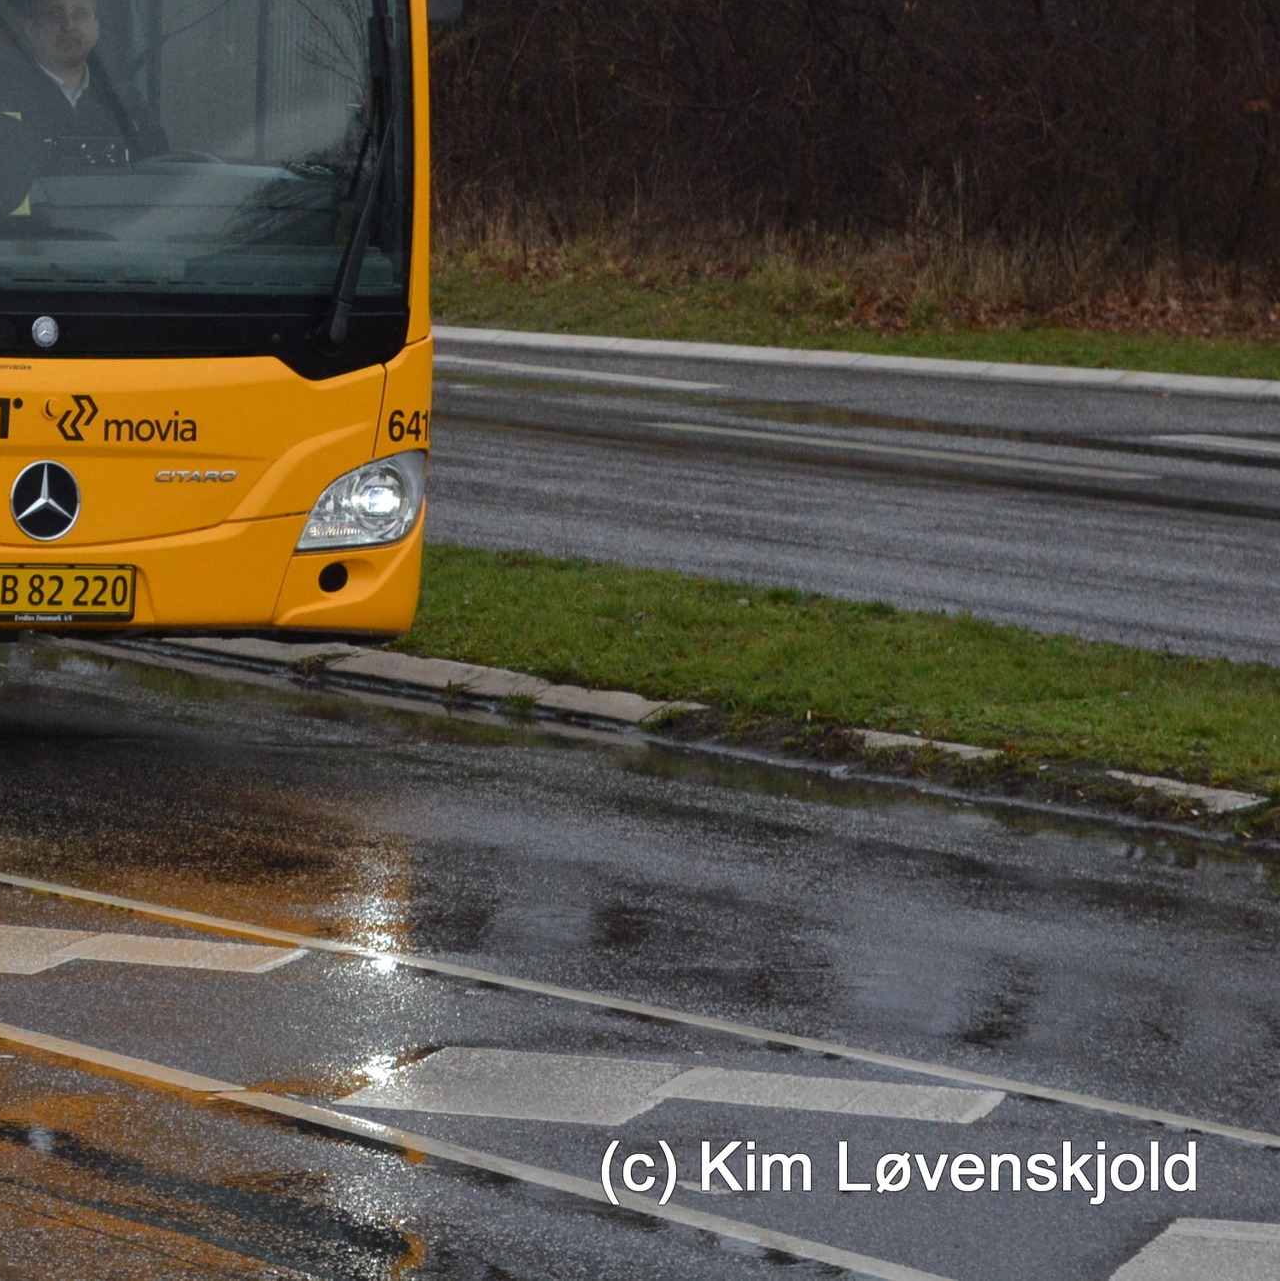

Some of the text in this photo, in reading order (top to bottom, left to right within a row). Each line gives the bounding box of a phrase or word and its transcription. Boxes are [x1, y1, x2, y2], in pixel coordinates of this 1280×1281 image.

[104, 410, 197, 442] movia
[155, 470, 238, 483] CITARO
[27, 574, 64, 606] 82
[72, 575, 129, 607] 220
